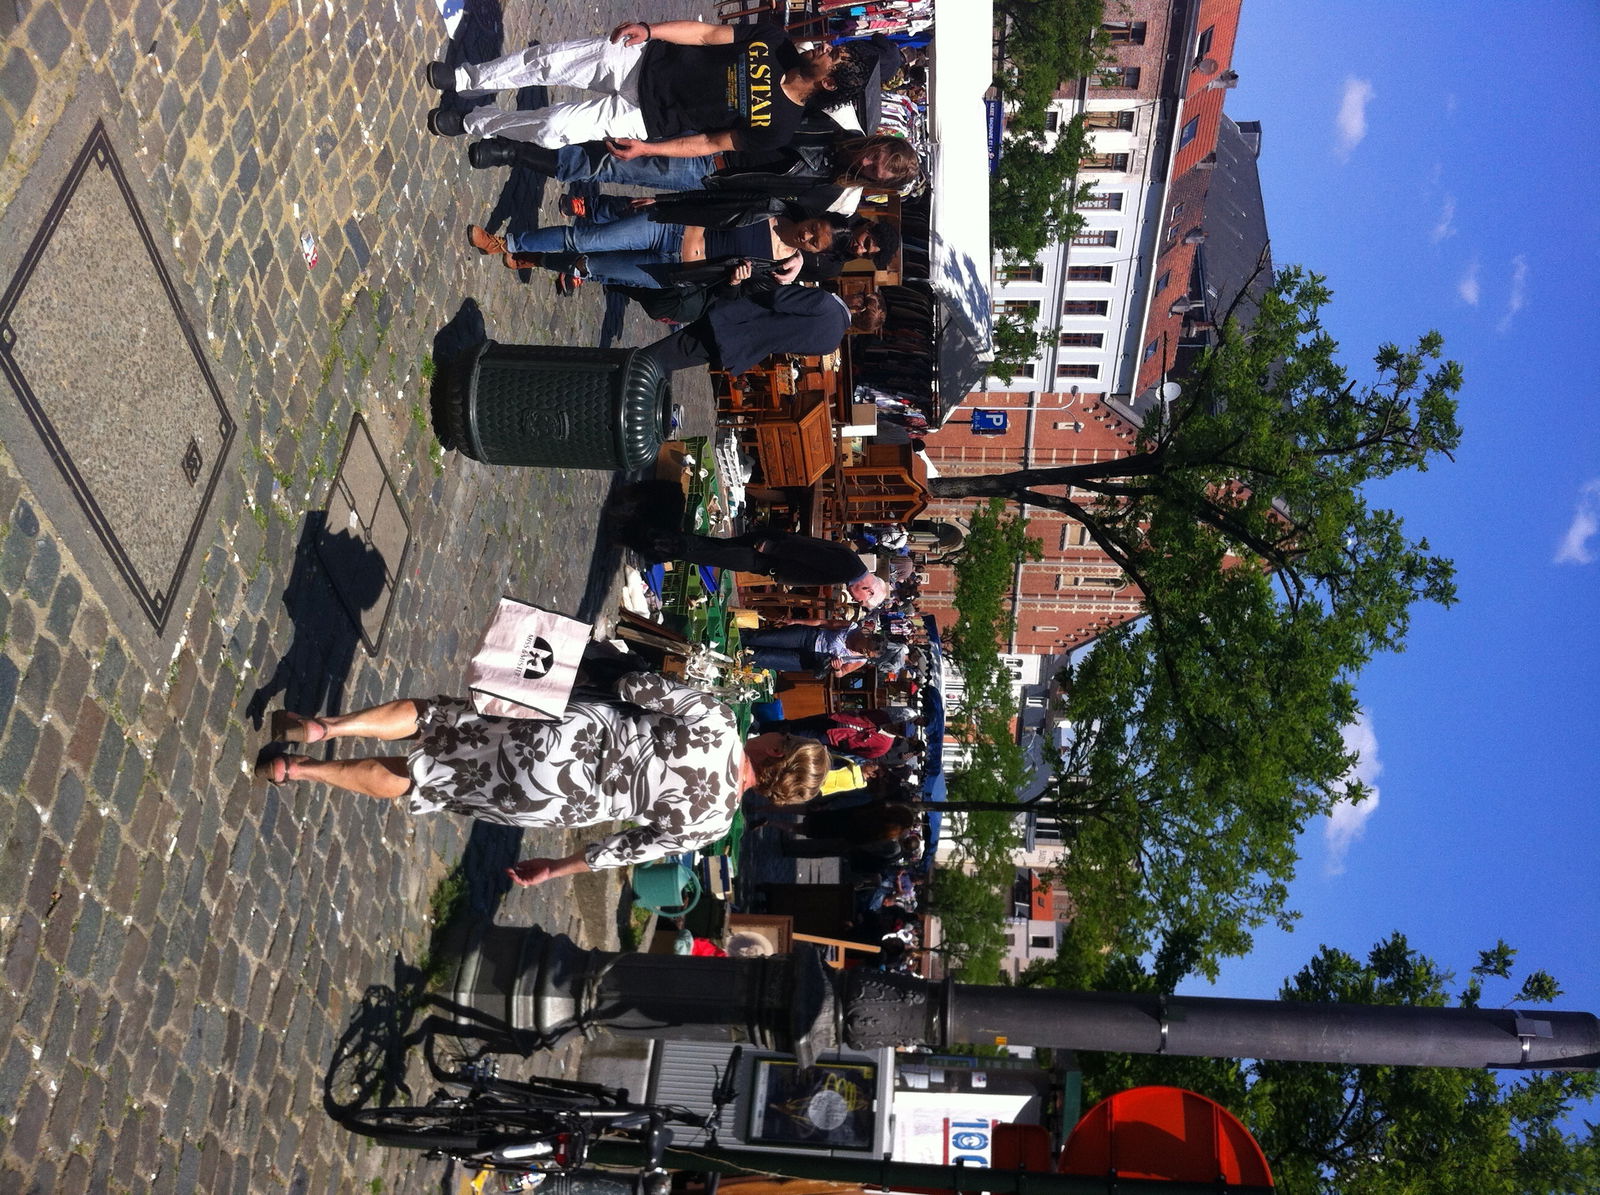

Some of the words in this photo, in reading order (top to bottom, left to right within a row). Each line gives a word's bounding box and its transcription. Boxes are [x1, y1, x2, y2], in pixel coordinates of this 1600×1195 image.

[748, 41, 772, 128] G.STAR
[986, 414, 1003, 426] P
[523, 633, 534, 649] MISS
